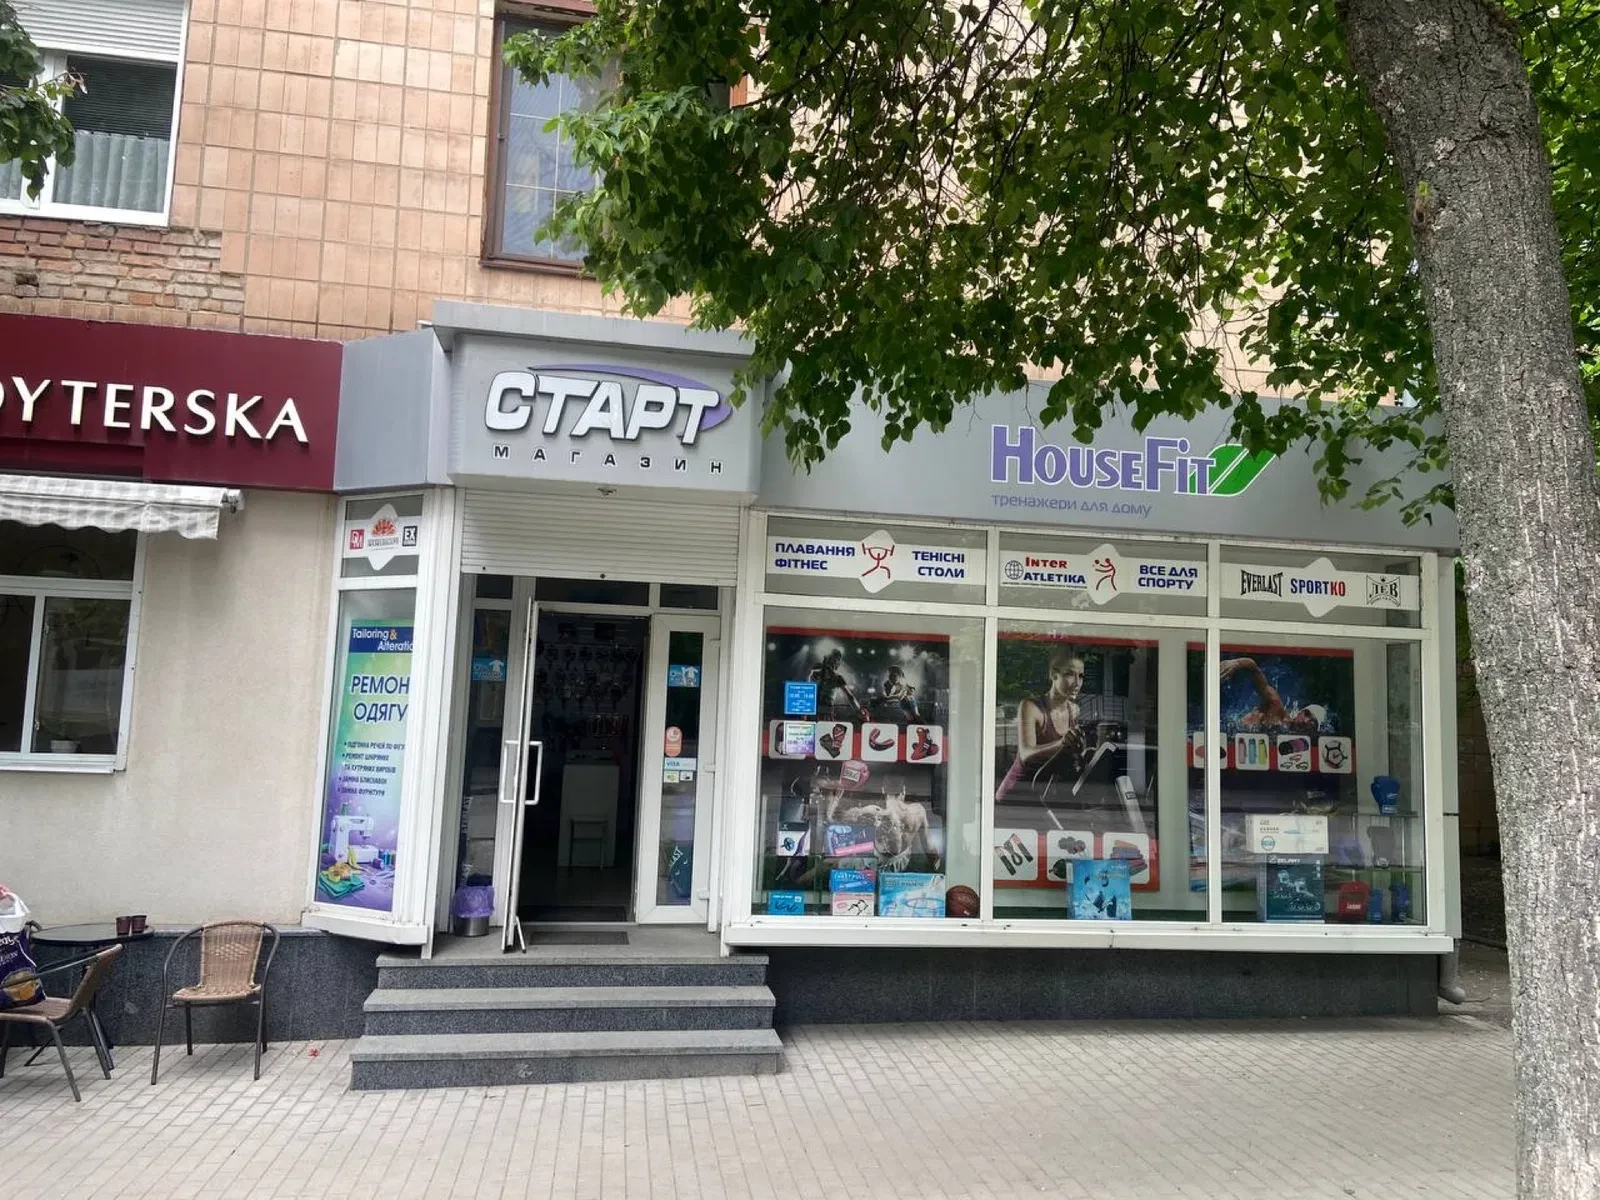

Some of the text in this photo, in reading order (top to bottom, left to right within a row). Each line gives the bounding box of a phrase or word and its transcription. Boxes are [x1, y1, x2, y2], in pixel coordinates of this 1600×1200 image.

[0, 376, 309, 443] YTERSKA
[485, 371, 721, 446] СТАРТ
[494, 445, 722, 474] МАГАЗИН
[991, 494, 1152, 519] тренажери для дому
[775, 542, 855, 557] ПЛАВАННЯ
[912, 550, 965, 563] ТЕНІСНІ
[775, 558, 828, 571] ФІТНЕС
[1139, 564, 1198, 578] ВСЕ ДЛЯ
[917, 566, 965, 579] СТОЛИ
[1023, 571, 1086, 584] ATLETIKA
[1138, 577, 1194, 590] СПОРТУ
[1240, 569, 1284, 598] EVERLAST
[1290, 578, 1346, 597] SPORTKO
[352, 628, 397, 641] Tailoring &
[353, 702, 409, 722] ОДЯГУ
